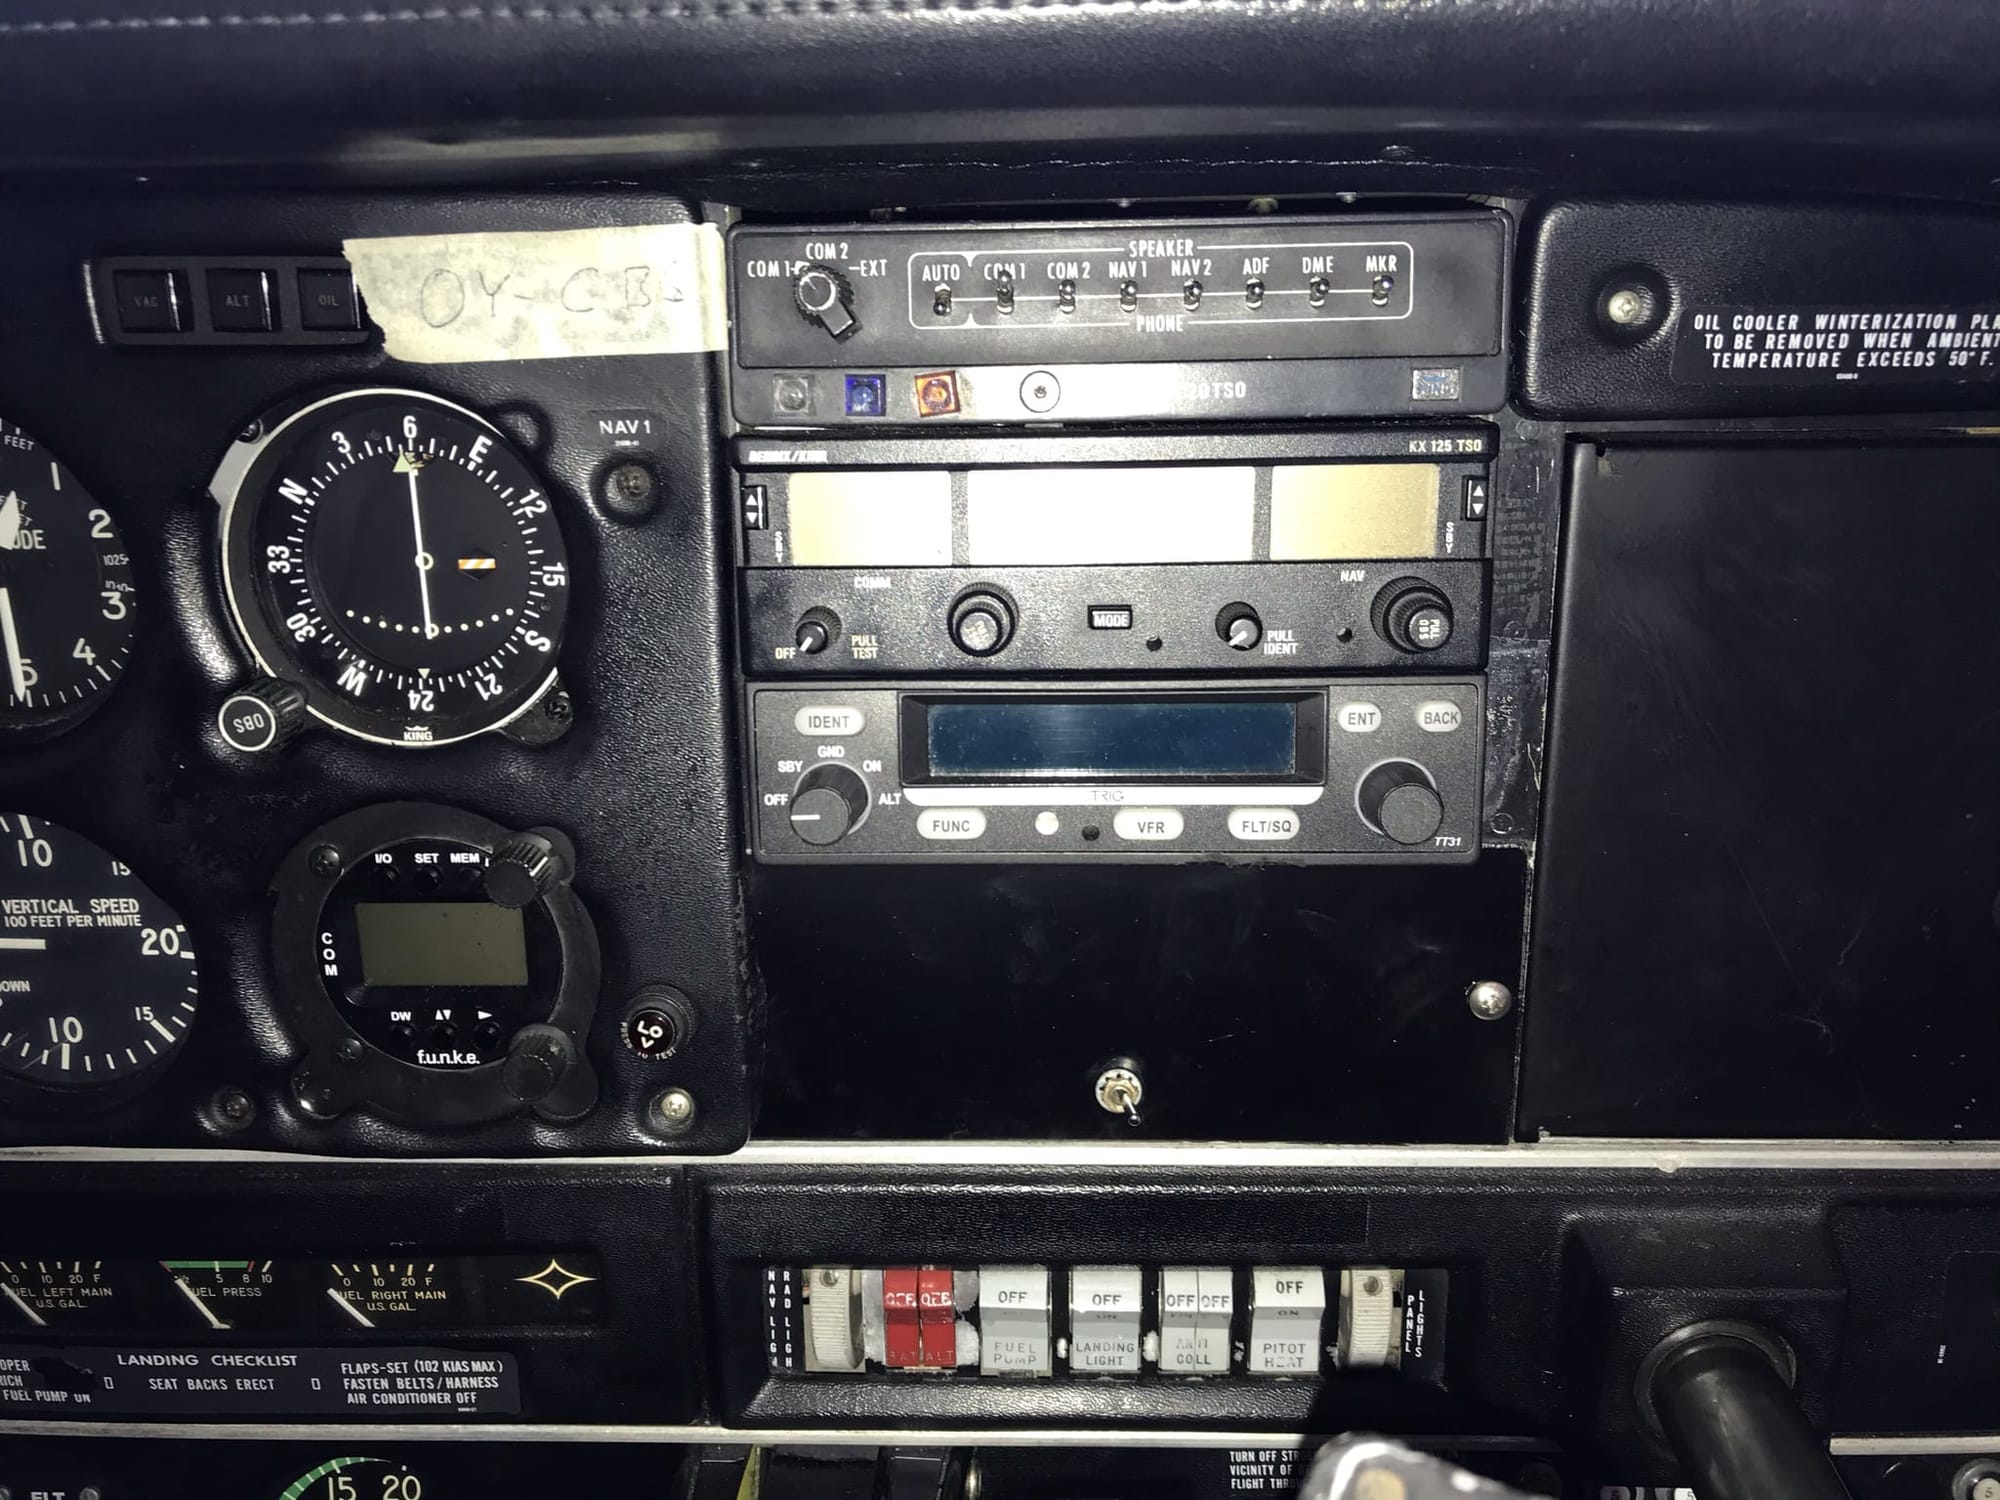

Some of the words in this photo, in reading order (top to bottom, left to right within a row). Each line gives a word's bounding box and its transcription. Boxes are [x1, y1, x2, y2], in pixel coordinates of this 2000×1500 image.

[806, 242, 836, 260] COM
[840, 242, 849, 259] 2
[1129, 239, 1194, 257] SPEAKER
[747, 260, 780, 277] COM
[784, 260, 790, 277] 1
[861, 259, 888, 277] EXT
[1047, 262, 1079, 279] COM
[1082, 261, 1091, 278] 2
[1109, 261, 1138, 278] NAV
[1142, 261, 1148, 277] 1
[1171, 260, 1200, 276] NAV
[1202, 260, 1212, 276] 2
[1243, 258, 1270, 274] ADF
[1302, 256, 1334, 273] DME
[1366, 255, 1397, 272] MKR
[922, 264, 960, 282] AUTO
[225, 296, 250, 307] ALT
[319, 295, 339, 307] OIL
[1136, 315, 1185, 332] PHONE
[1694, 314, 1719, 330] OIL
[1732, 314, 1799, 330] COOLER
[1815, 313, 1957, 330] WINTERIZATION
[1704, 334, 1724, 349] TO
[1733, 334, 1754, 349] BE
[1765, 334, 1850, 349] REMOVED
[1863, 333, 1912, 348] WHEN
[1926, 332, 2000, 348] AMBIENT
[1711, 352, 1842, 369] TEMPERATURE
[1856, 351, 1936, 367] EXCEEDS
[1979, 350, 1994, 366] F.
[403, 415, 417, 438] 6
[599, 419, 639, 434] NAV
[643, 419, 651, 434] 1
[4, 435, 35, 450] FEET
[331, 431, 351, 453] 3
[1408, 440, 1427, 453] KX
[1430, 439, 1452, 453] 125
[1456, 439, 1482, 452] TSO
[468, 435, 493, 463] E
[278, 478, 308, 504] N
[519, 489, 547, 517] 12
[88, 509, 114, 538] 2
[1446, 521, 1454, 553] SBY
[103, 553, 129, 566] 1025
[267, 544, 290, 573] 33
[542, 562, 565, 586] 15
[1340, 570, 1365, 582] NAV
[854, 577, 891, 588] COMM
[101, 591, 126, 620] 3
[286, 612, 316, 642] 30
[1094, 614, 1128, 627] MODE
[524, 630, 550, 653] S
[852, 635, 877, 647] PULL
[1267, 630, 1294, 642] PULL
[72, 638, 96, 666] 4
[775, 648, 796, 660] OFF
[852, 648, 878, 660] TEST
[1263, 643, 1299, 655] IDENT
[337, 665, 368, 696] W
[474, 674, 502, 700] 21
[408, 689, 434, 711] 24
[233, 713, 265, 733] OBS
[808, 716, 850, 729] IDENT
[1347, 712, 1376, 725] ENT
[1424, 712, 1458, 725] BACK
[404, 730, 432, 741] KING
[817, 746, 845, 758] GND
[778, 761, 803, 773] SBY
[863, 760, 882, 772] ON
[764, 794, 789, 806] OFF
[879, 793, 901, 805] ALT
[933, 820, 971, 832] FUNC
[1137, 821, 1165, 834] VFR
[1242, 820, 1292, 834] FLT/SQ
[1435, 836, 1461, 847] TT31
[18, 839, 53, 867] 10
[375, 854, 392, 864] I/O
[414, 853, 439, 864] SET
[450, 853, 480, 864] MEM
[112, 861, 131, 876] 15
[2, 899, 79, 914] VERTICAL
[90, 899, 140, 914] SPEED
[4, 916, 27, 928] 100
[31, 916, 62, 928] FEET
[67, 915, 93, 927] PER
[98, 915, 142, 927] MINUTE
[141, 928, 179, 955] 20
[321, 932, 338, 976] COM
[135, 1006, 153, 1021] 15
[391, 1011, 412, 1021] DW
[49, 1016, 82, 1043] 10
[637, 1020, 663, 1038] LO
[417, 1050, 480, 1065] f.u.n.k.e.
[11, 1274, 20, 1284] 0
[41, 1274, 53, 1284] 10
[68, 1274, 84, 1284] 20
[93, 1273, 101, 1283] F
[215, 1273, 224, 1283] 5
[242, 1273, 250, 1283] 8
[261, 1274, 273, 1284] 10
[343, 1277, 351, 1287] 0
[373, 1277, 385, 1287] 10
[400, 1277, 416, 1287] 20
[425, 1277, 433, 1287] F
[42, 1287, 74, 1297] LEFT
[80, 1287, 113, 1297] MAIN
[222, 1287, 262, 1297] PRESS
[768, 1270, 776, 1308] NAV
[783, 1270, 791, 1309] RAD
[1276, 1281, 1304, 1294] OFF
[371, 1290, 408, 1300] RIGHT
[414, 1290, 447, 1300] MAIN
[998, 1291, 1027, 1304] OFF
[1092, 1294, 1122, 1306] OFF
[1166, 1294, 1195, 1307] OFF
[1201, 1295, 1230, 1308] OFF
[1405, 1294, 1415, 1353] PANEL
[1415, 1289, 1425, 1358] LIGHTS
[995, 1342, 1036, 1353] FUEL
[1076, 1343, 1135, 1352] LANDING
[1263, 1343, 1306, 1354] PITOT
[117, 1354, 199, 1366] LANDING
[211, 1355, 298, 1367] CHECKLIST
[1086, 1356, 1124, 1366] LIGHT
[1176, 1354, 1211, 1365] COLL
[341, 1361, 409, 1375] FLAPS-SET
[414, 1359, 439, 1374] (102
[442, 1360, 470, 1373] KIAS
[149, 1378, 179, 1390] SEAT
[187, 1378, 228, 1391] BACKS
[236, 1378, 275, 1391] ERECT
[343, 1378, 389, 1390] FASTEN
[2, 1389, 33, 1401] FUEL
[34, 1390, 68, 1402] PUMP
[347, 1393, 367, 1404] AIR
[372, 1392, 451, 1404] CONDITIONER
[456, 1392, 477, 1404] OFF
[1229, 1450, 1255, 1462] TURN
[1259, 1450, 1278, 1462] OFF
[1229, 1464, 1274, 1476] VICINITY
[1280, 1464, 1293, 1476] OF
[328, 1476, 357, 1500] 15
[382, 1474, 421, 1500] 20
[1231, 1478, 1264, 1489] FLIGHT
